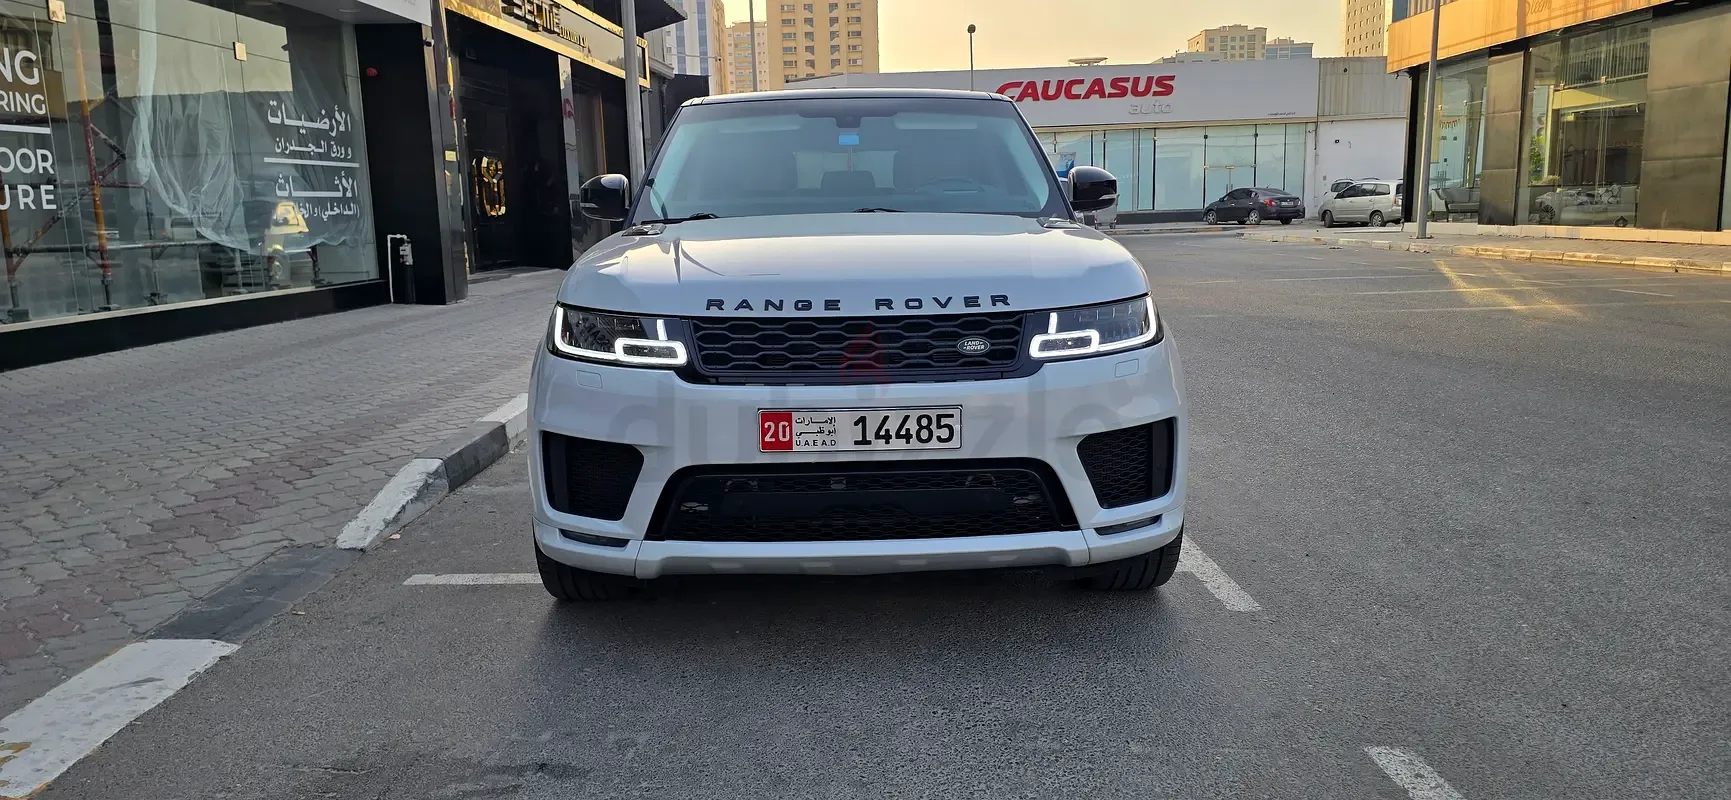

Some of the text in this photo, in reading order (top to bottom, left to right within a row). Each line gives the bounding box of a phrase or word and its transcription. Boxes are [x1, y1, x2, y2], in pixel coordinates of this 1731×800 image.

[995, 75, 1176, 102] CAUCASUS
[1128, 100, 1173, 115] auto
[705, 294, 1011, 312] RANGE ROVER
[764, 421, 790, 442] 20
[853, 413, 955, 446] 14485
